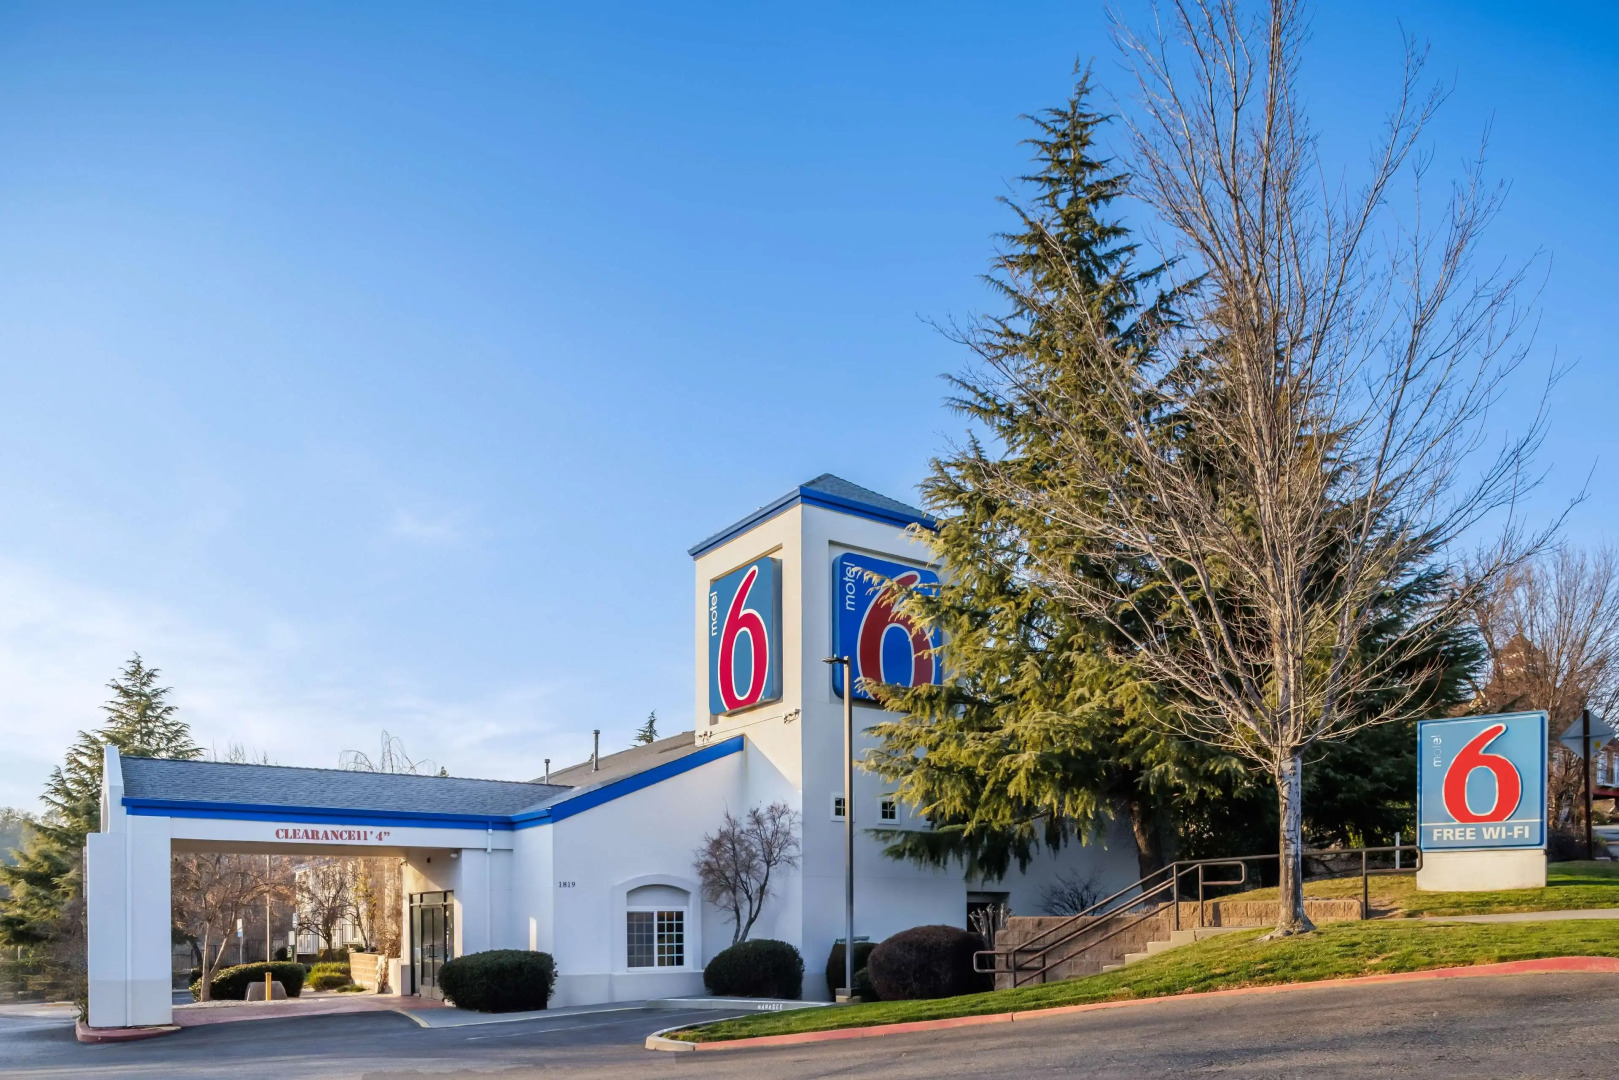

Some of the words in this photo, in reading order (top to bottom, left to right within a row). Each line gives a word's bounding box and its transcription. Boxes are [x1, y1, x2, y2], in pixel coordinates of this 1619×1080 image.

[709, 591, 718, 636] motel
[842, 561, 856, 611] motel
[717, 565, 769, 711] 6
[857, 570, 936, 701] 6
[1442, 723, 1522, 823] 6
[1433, 827, 1476, 841] FREE
[1482, 825, 1530, 839] WI-FI
